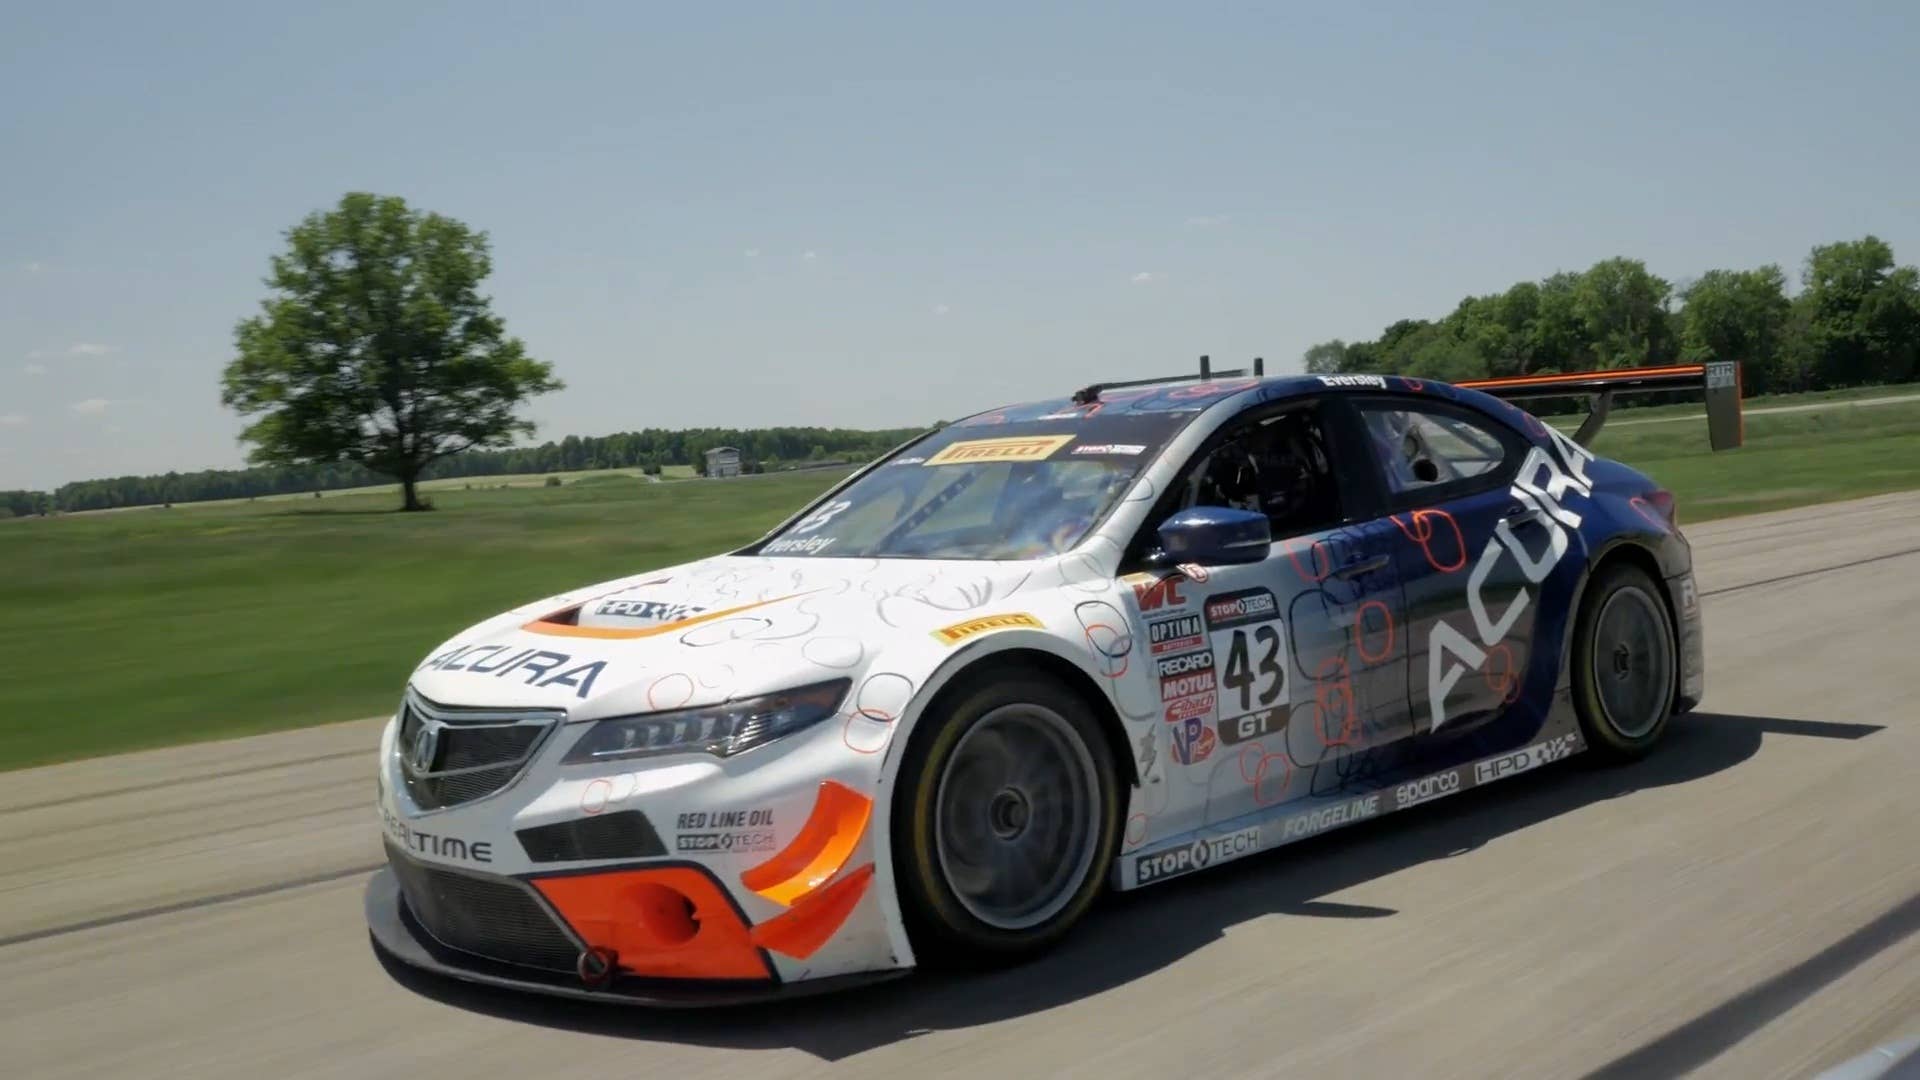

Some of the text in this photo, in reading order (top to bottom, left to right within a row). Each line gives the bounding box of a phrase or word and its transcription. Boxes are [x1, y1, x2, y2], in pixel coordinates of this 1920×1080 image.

[1317, 375, 1387, 389] Eversley
[940, 440, 1057, 460] PIRELLI
[1428, 421, 1595, 734] ACURA
[597, 600, 649, 616] HPD
[1210, 602, 1236, 618] STOP
[1246, 596, 1273, 611] TECH
[940, 613, 1035, 640] PIRELLI
[1151, 616, 1200, 642] OPTIMA
[418, 645, 608, 698] ACURA
[1160, 652, 1213, 676] RECARO
[1223, 625, 1284, 711] 43
[1163, 672, 1214, 700] MOTUL
[1238, 711, 1272, 739] GT
[1173, 717, 1203, 765] VP
[677, 808, 774, 829] RED LINE OIL
[1140, 752, 1531, 880] STOP TECH FORGELINE sparco HPD
